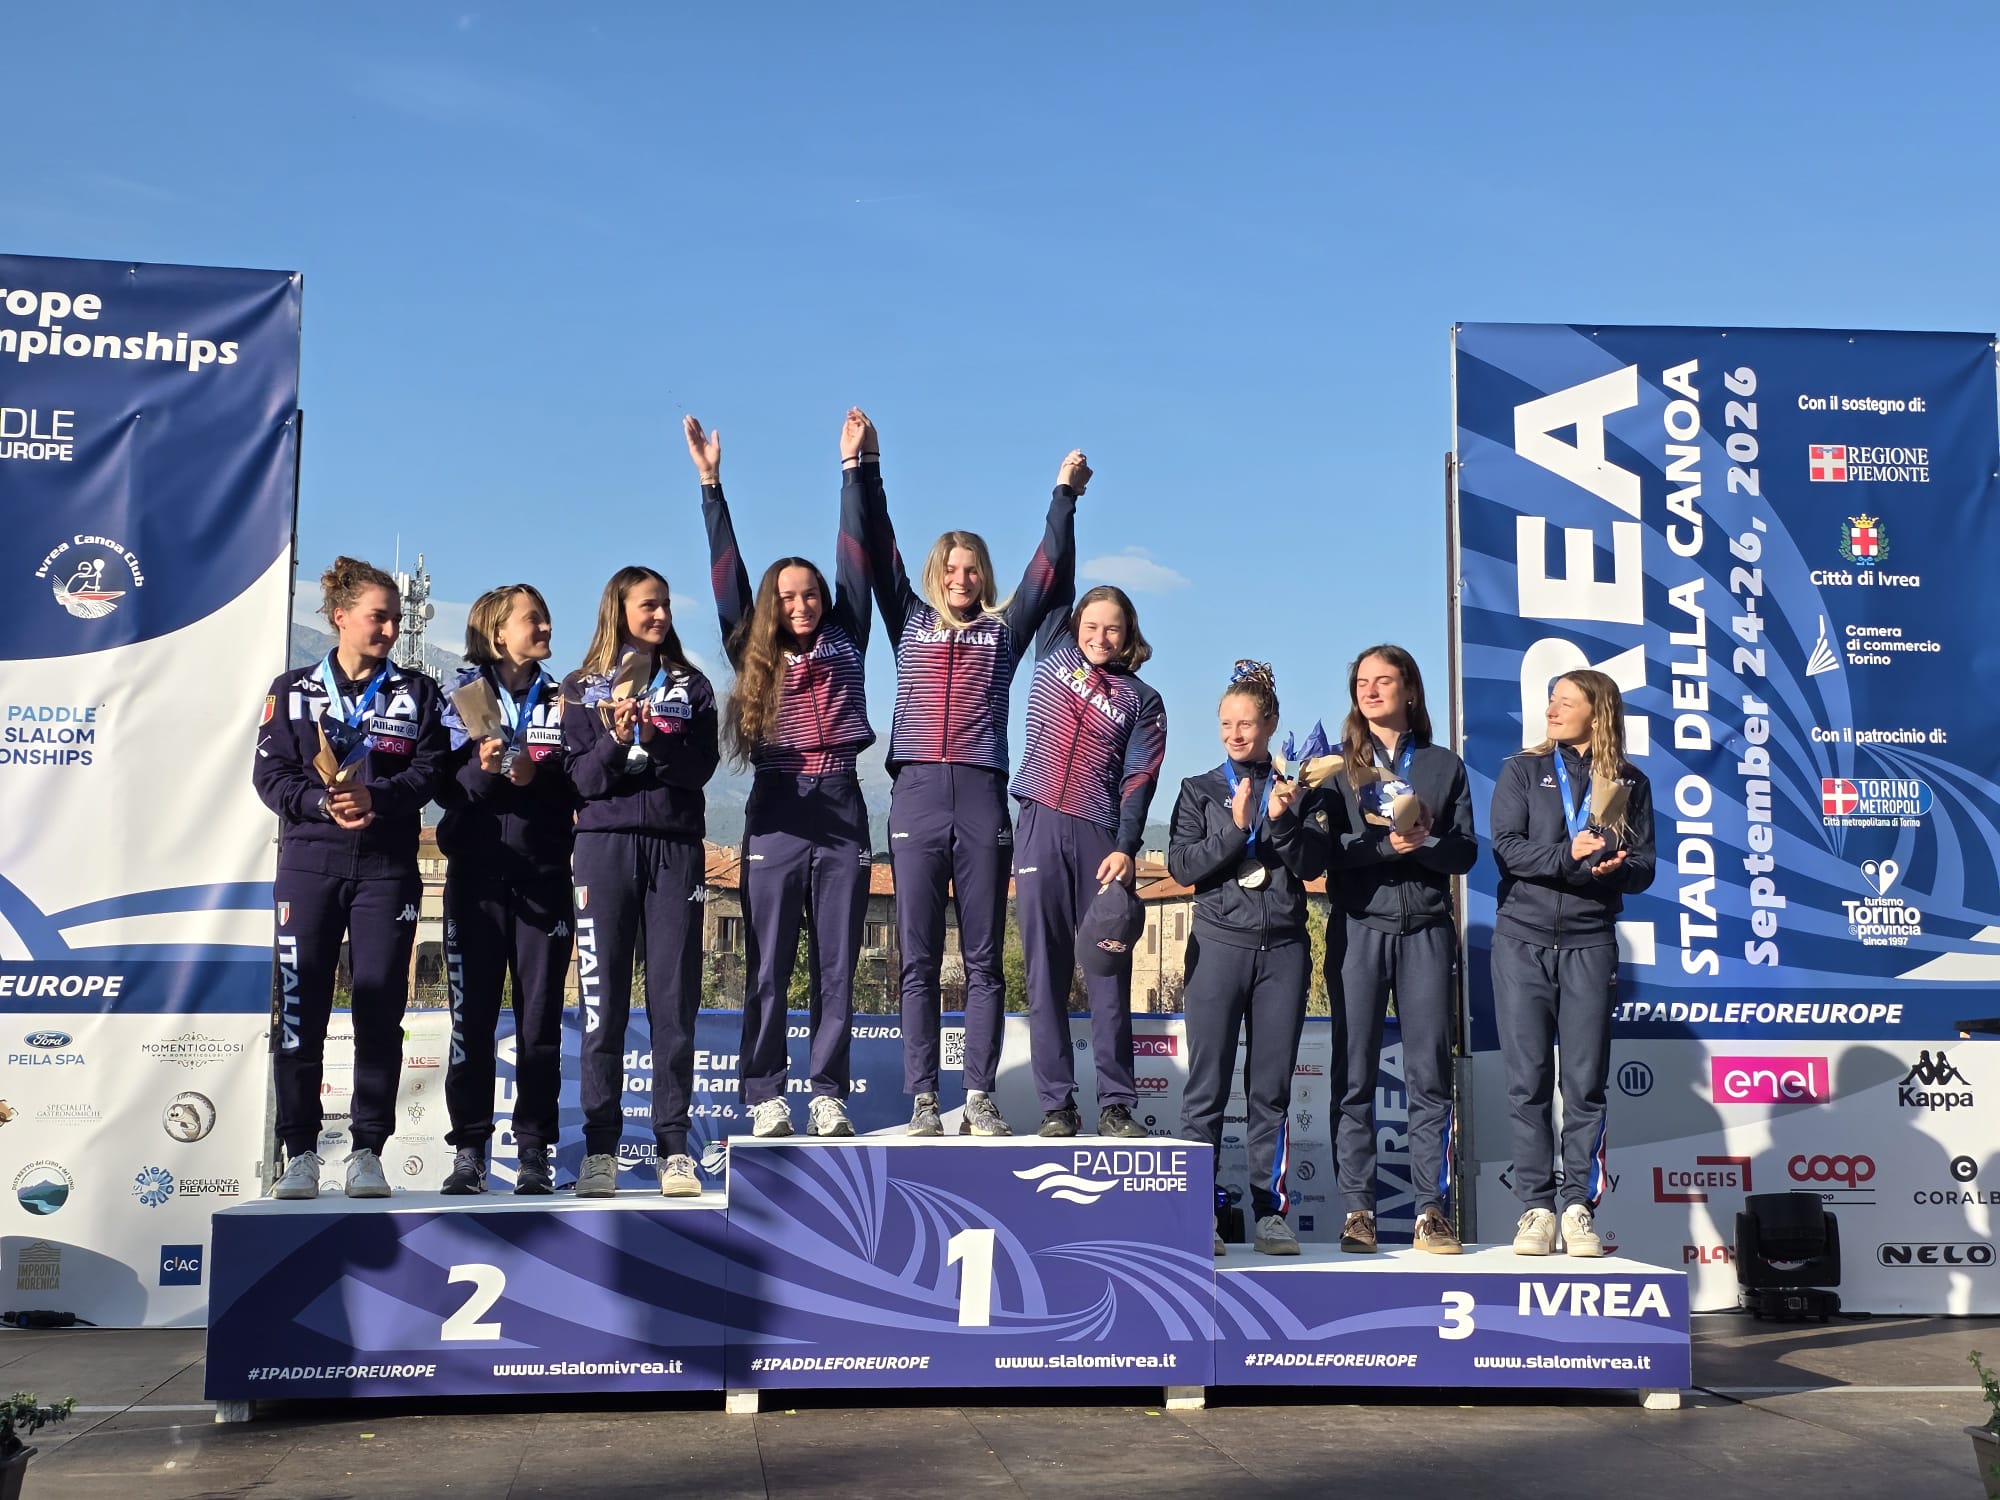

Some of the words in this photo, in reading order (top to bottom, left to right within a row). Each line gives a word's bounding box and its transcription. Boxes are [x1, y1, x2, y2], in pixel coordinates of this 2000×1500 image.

[1798, 394, 1827, 410] Con
[1829, 396, 1838, 410] il
[1842, 397, 1905, 415] sostegno
[1908, 397, 1926, 413] di:
[1724, 366, 1760, 497] 2026
[1662, 358, 1703, 557] CANOA
[1848, 447, 1929, 465] REGIONE
[1849, 466, 1930, 483] PIEMONTE
[35, 542, 70, 578] Ivrea
[74, 534, 125, 555] Canoa
[123, 551, 145, 587] Club
[1810, 570, 1853, 586] Città
[1857, 571, 1874, 586] di
[1878, 572, 1920, 587] Ivrea
[1729, 516, 1767, 677] 24-26,
[1845, 624, 1902, 638] Camera
[1846, 639, 1861, 651] di
[1863, 640, 1941, 652] commercio
[1668, 577, 1712, 750] DELLA
[1847, 653, 1891, 665] Torino
[8, 706, 96, 723] PADDLE
[372, 719, 405, 733] Allianz
[5, 727, 95, 744] SLALOM
[1811, 727, 1840, 743] Con
[1843, 728, 1852, 743] il
[1856, 728, 1926, 746] patrocinio
[1929, 729, 1947, 744] di:
[377, 740, 405, 753] enel
[0, 748, 93, 766] ONSHIPS
[1859, 780, 1920, 798] TORINO
[1859, 799, 1920, 815] METROPOLI
[1737, 694, 1786, 967] September
[1842, 817, 1890, 828] metropolitana
[1900, 818, 1921, 827] Torino
[1674, 774, 1720, 975] STADIO
[1864, 896, 1904, 906] turismo
[1842, 900, 1921, 924] Torino
[1863, 937, 1887, 945] since
[1888, 937, 1908, 946] 1997
[576, 918, 600, 1033] ITALIA
[277, 935, 300, 1050] ITALIA
[447, 953, 468, 1065] ITALIA
[32, 1033, 64, 1047] Ford
[141, 1043, 244, 1053] MOMENTIGOLOSI
[8, 1054, 52, 1065] PEILA
[55, 1054, 85, 1065] SPA
[1724, 1062, 1818, 1098] enel
[1898, 1086, 1974, 1111] Kappa
[1073, 1151, 1188, 1176] PADDLE
[1788, 1154, 1876, 1189] coop
[12, 1162, 35, 1191] DISTRETTO
[1123, 1177, 1188, 1192] EUROPE
[1668, 1171, 1737, 1187] COGEIS
[1913, 1191, 2000, 1205] CORALB
[1882, 1245, 1992, 1264] NELO
[18, 1263, 61, 1277] IMPRONTA
[947, 1228, 996, 1327] 1
[16, 1277, 60, 1290] MORENICA
[440, 1263, 507, 1341] 2
[1518, 1281, 1671, 1318] IVREA
[1438, 1290, 1476, 1340] 3
[493, 1358, 684, 1377] www.slalomivrea.it
[750, 1355, 930, 1371] #IPADDLEFOREUROPE
[995, 1352, 1177, 1369] www.slalomivrea.it
[1244, 1352, 1417, 1368] #IPADDLEFOREUROPE
[1473, 1354, 1651, 1370] www.slalomivrea.it
[247, 1363, 436, 1381] #IPADDLEFOREUROPE
